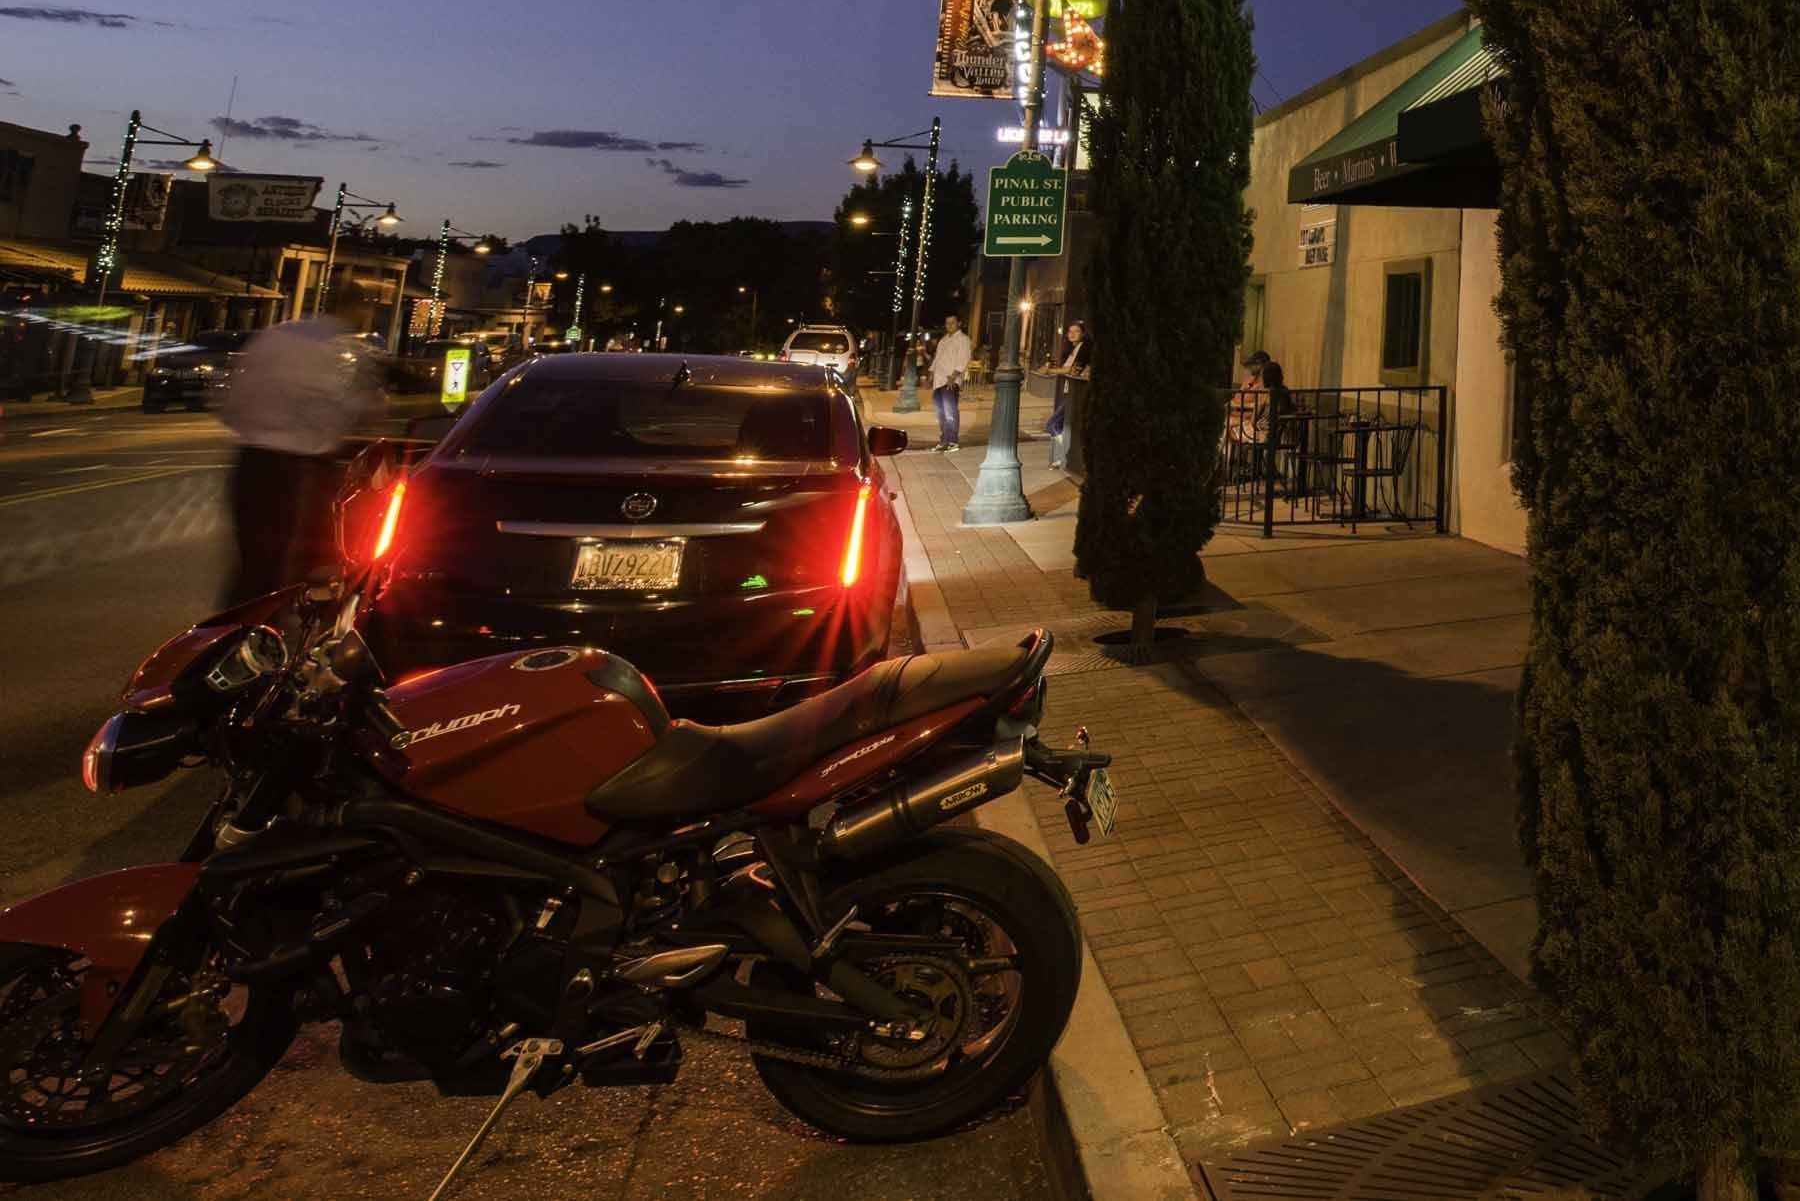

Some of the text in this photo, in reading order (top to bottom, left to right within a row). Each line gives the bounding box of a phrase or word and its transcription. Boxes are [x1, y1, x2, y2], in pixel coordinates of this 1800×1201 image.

[993, 178, 1062, 190] PINAL ST.
[1313, 167, 1331, 192] Beer
[1001, 196, 1054, 207] PUBLIC
[993, 213, 1057, 225] PARKING
[409, 703, 521, 744] riumph
